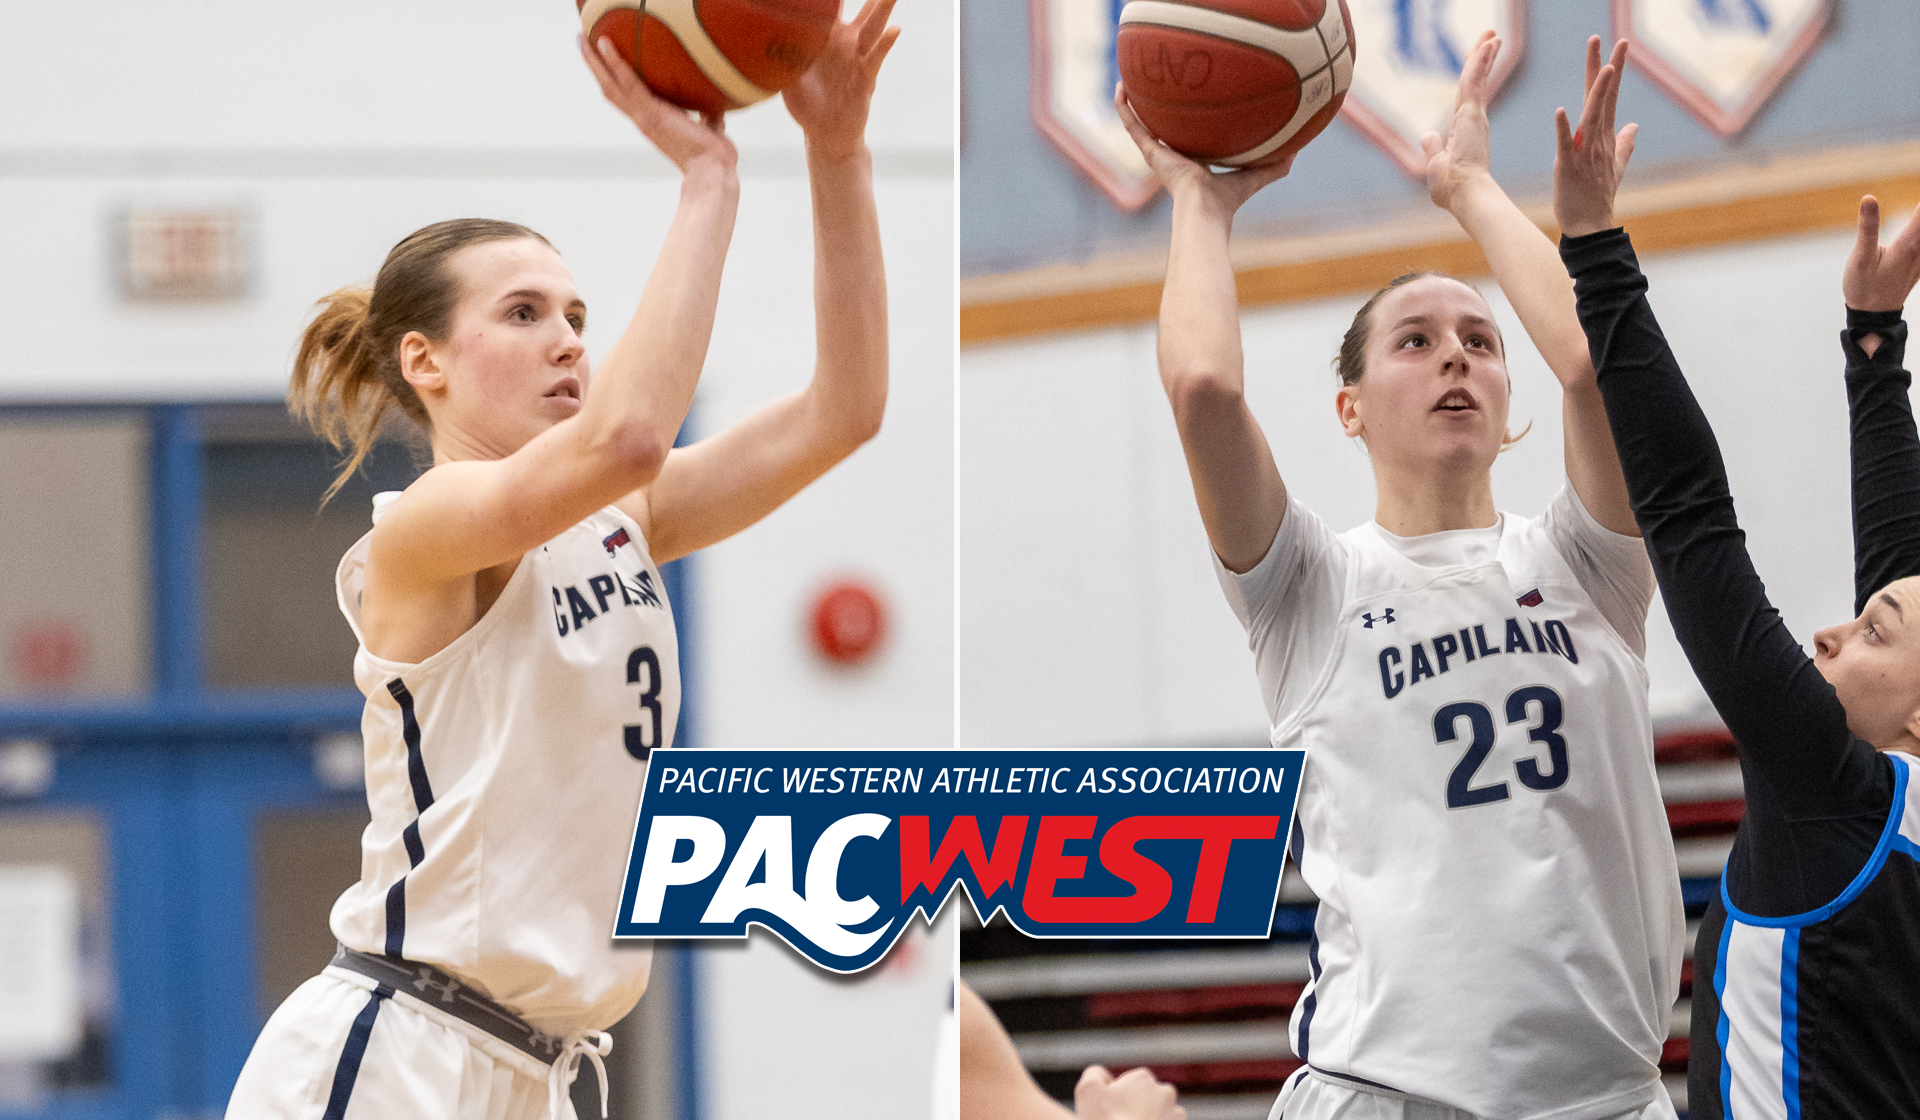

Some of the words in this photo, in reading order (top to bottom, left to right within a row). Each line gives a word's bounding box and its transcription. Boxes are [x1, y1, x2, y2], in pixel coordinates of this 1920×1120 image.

[622, 645, 662, 762] 3
[1377, 616, 1580, 700] CAPILANO
[1431, 683, 1571, 810] 23
